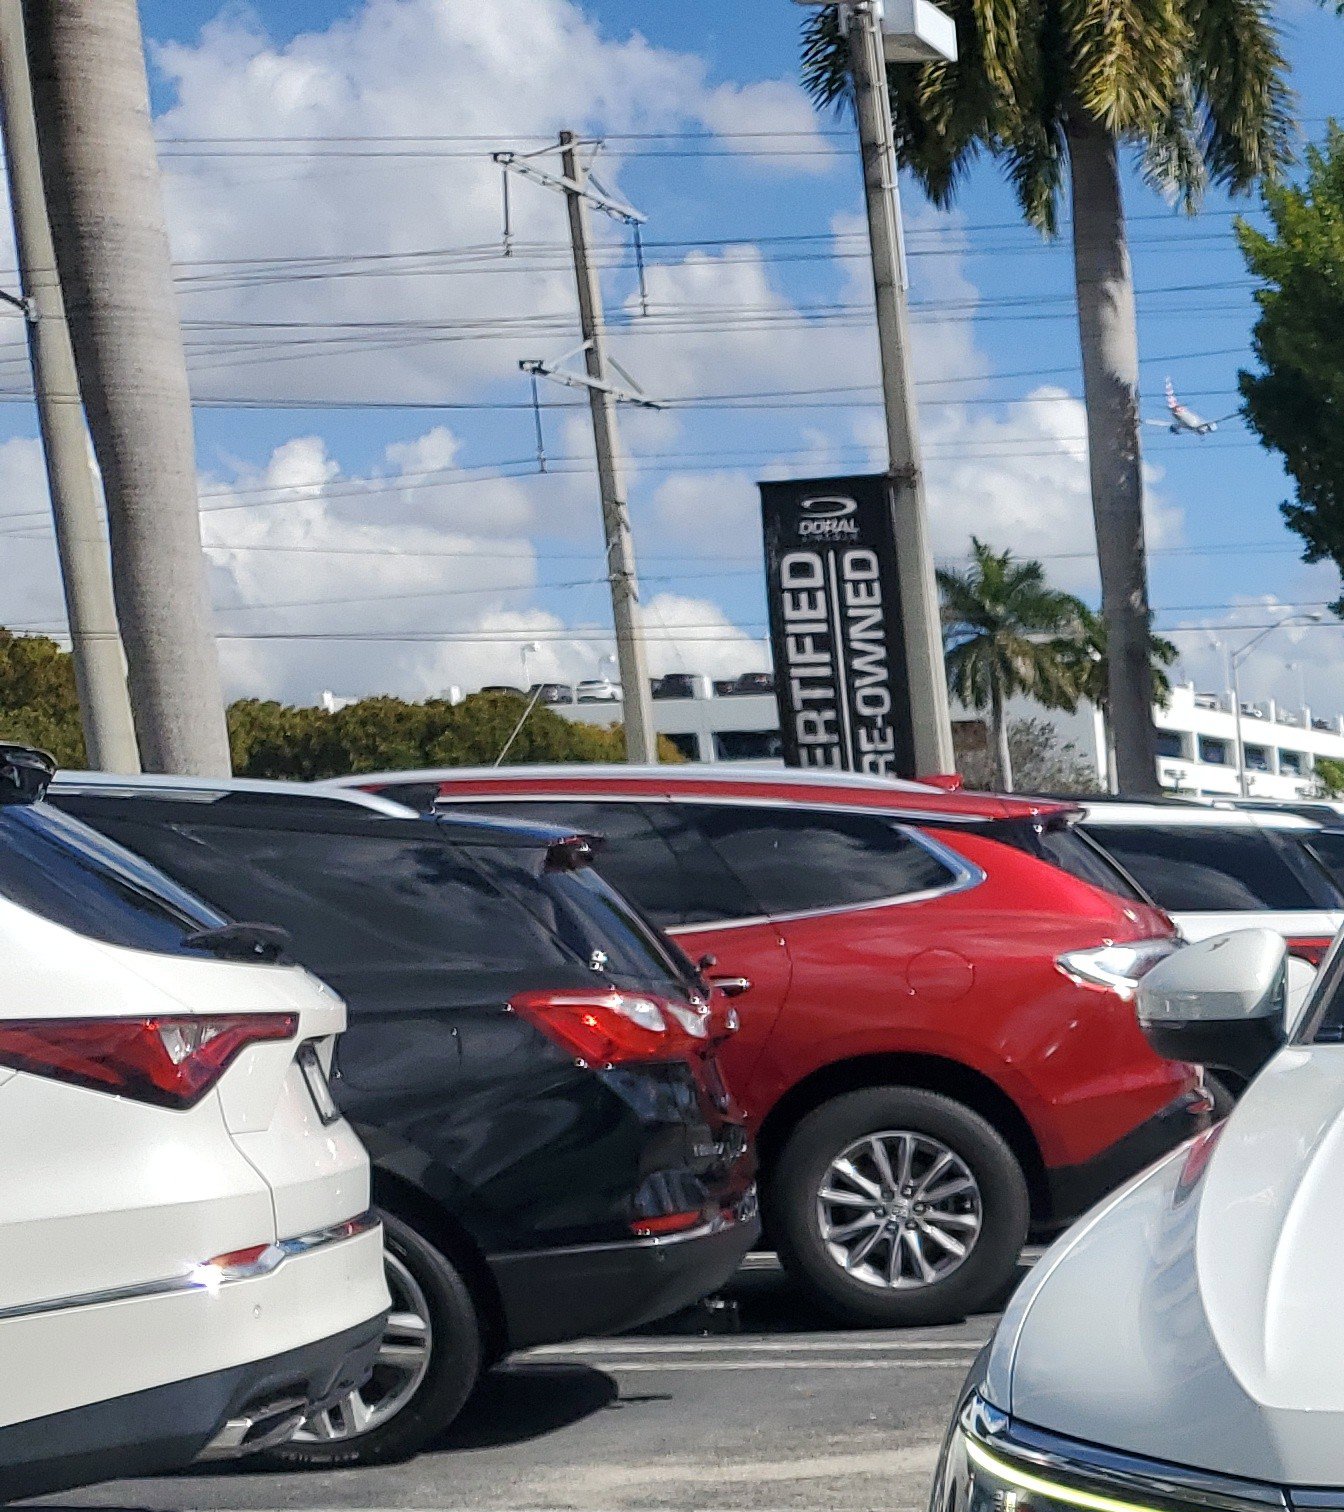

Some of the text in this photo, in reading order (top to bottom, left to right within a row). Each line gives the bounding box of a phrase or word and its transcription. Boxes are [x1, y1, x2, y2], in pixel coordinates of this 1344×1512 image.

[798, 518, 860, 535] DORAL
[780, 551, 841, 769] ERTIFIED
[842, 549, 897, 778] RE-OWNED
